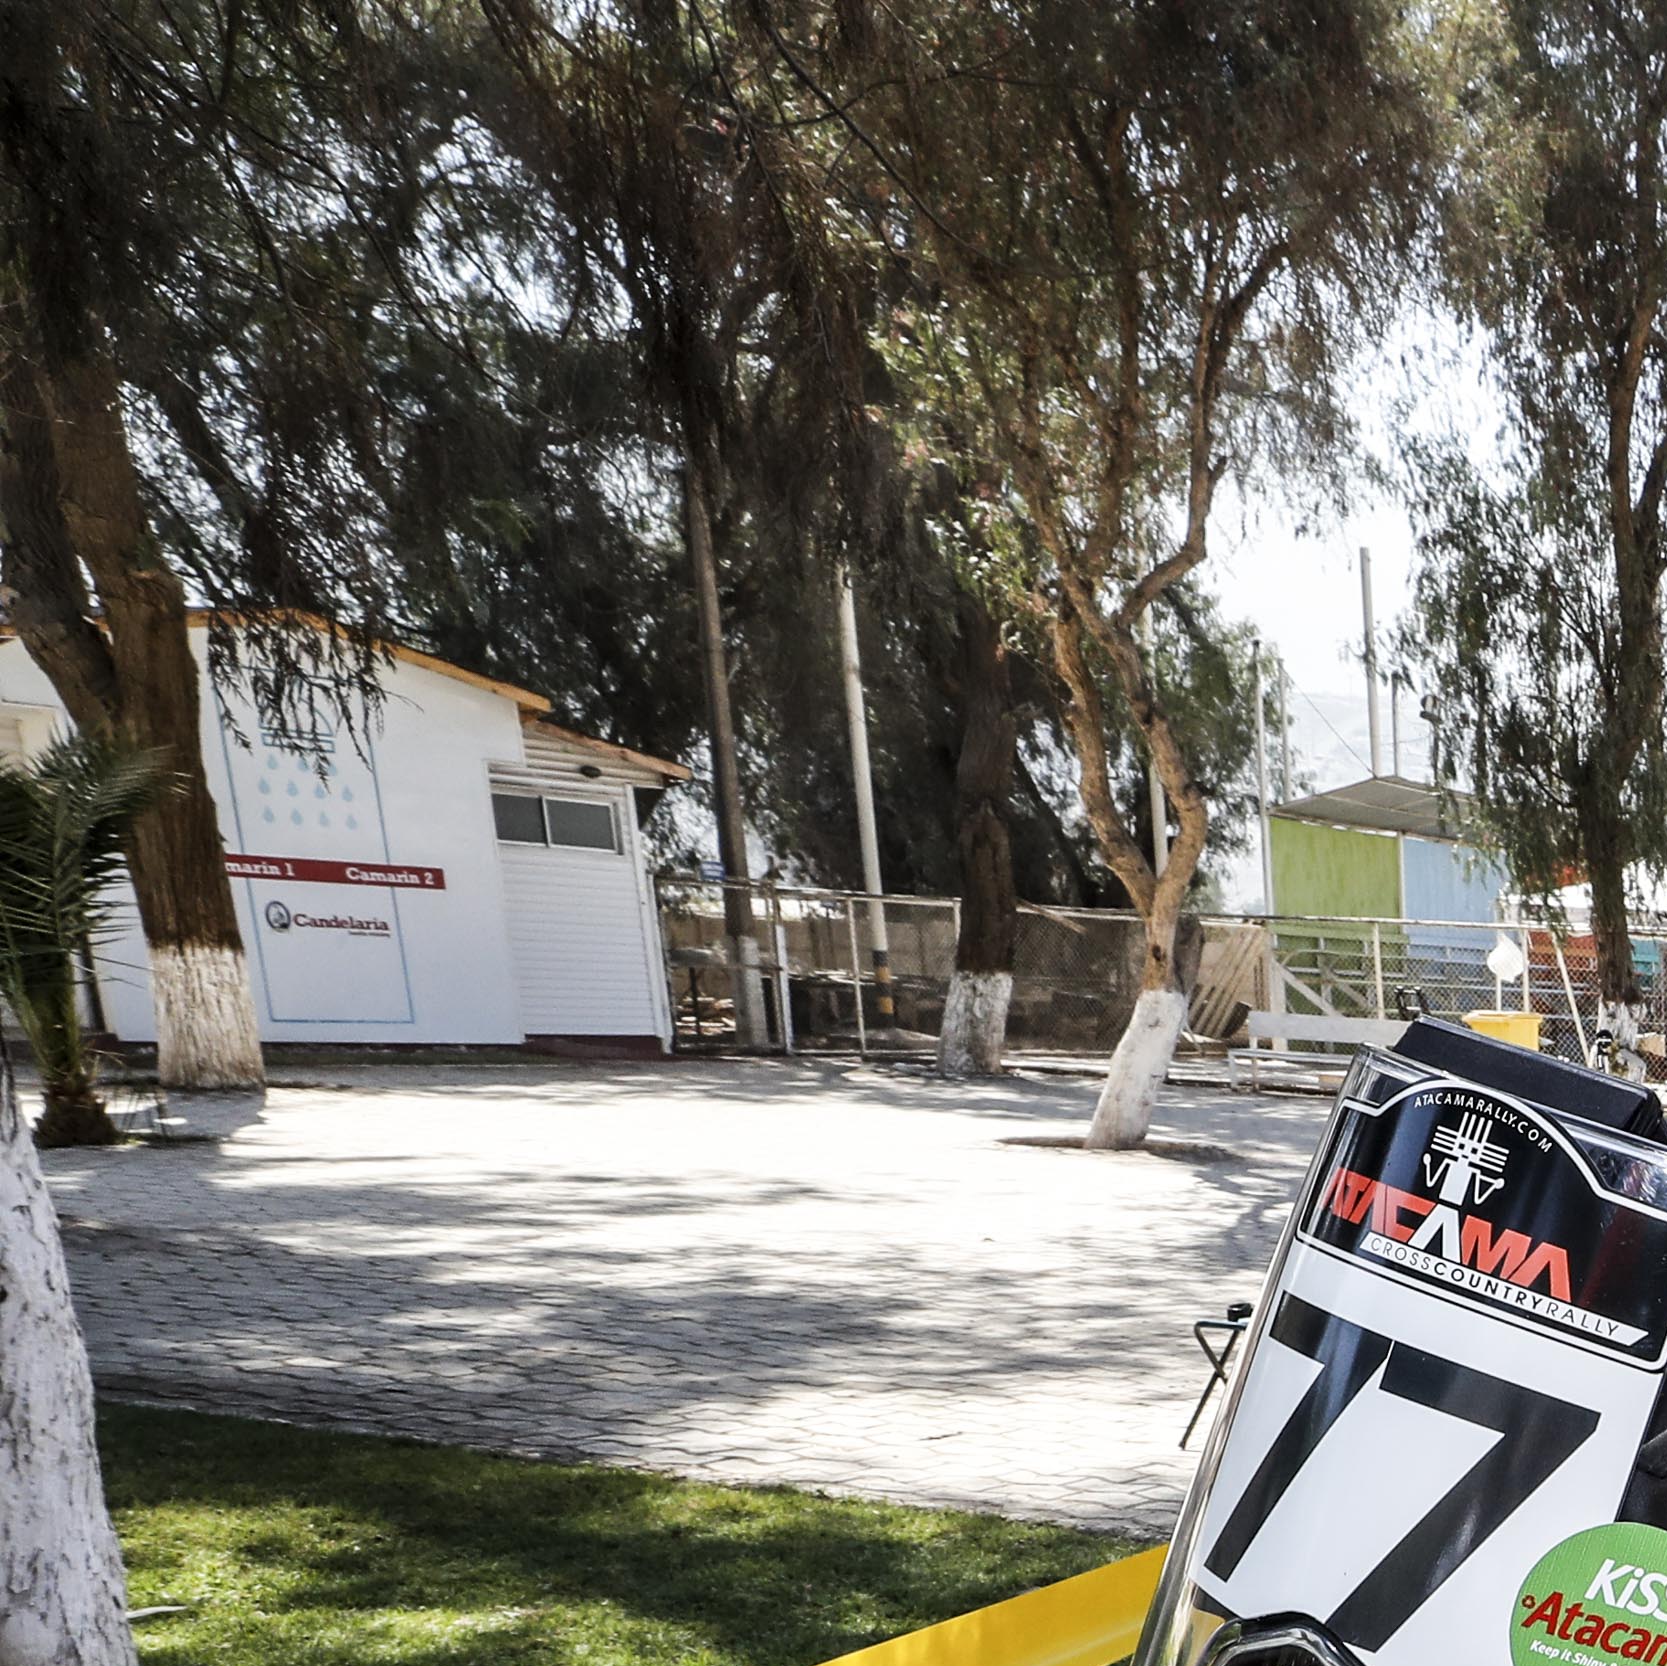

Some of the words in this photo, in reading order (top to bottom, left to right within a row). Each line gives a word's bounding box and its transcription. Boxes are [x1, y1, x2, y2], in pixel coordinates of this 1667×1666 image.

[285, 863, 295, 876] 1
[345, 867, 420, 884] Camarin
[425, 872, 435, 885] 2
[293, 913, 389, 931] Candelaria
[1414, 1092, 1552, 1153] ATACAMARALLY.COM
[1322, 1167, 1572, 1303] ATACAMA
[1205, 1291, 1600, 1652] 77
[1530, 1640, 1560, 1659] Keep
